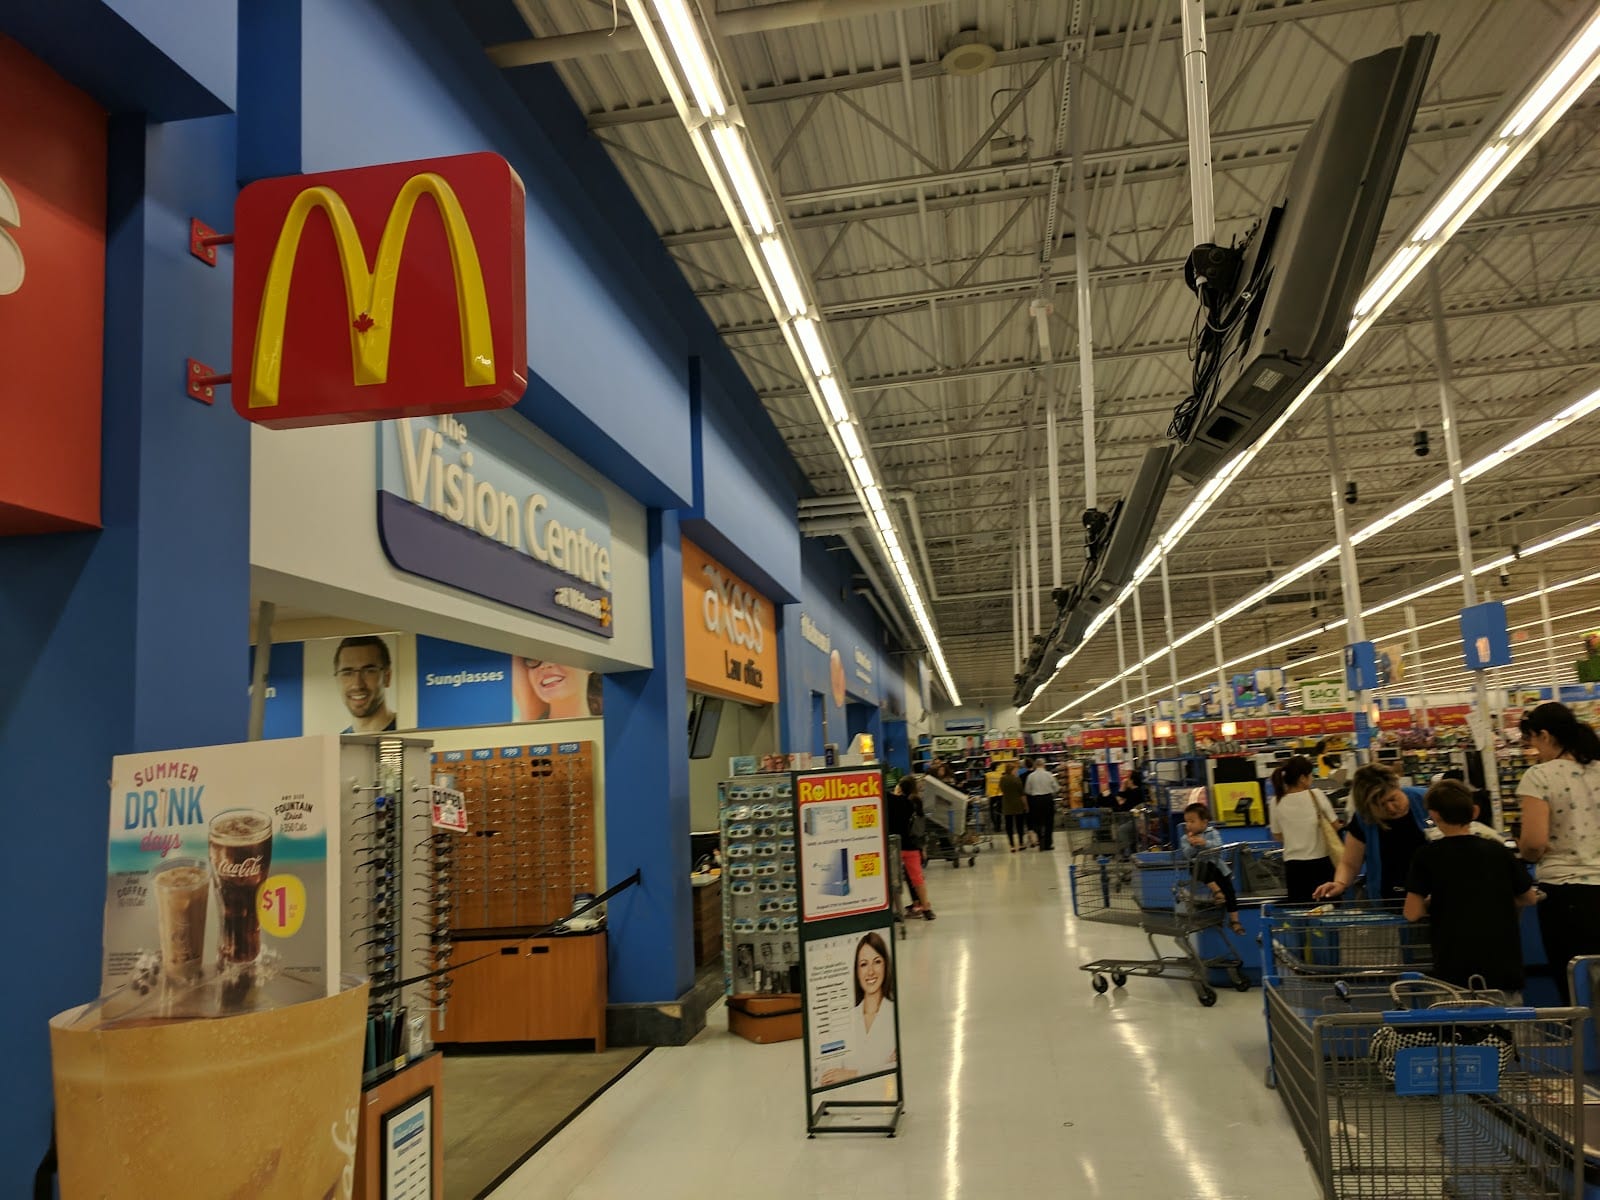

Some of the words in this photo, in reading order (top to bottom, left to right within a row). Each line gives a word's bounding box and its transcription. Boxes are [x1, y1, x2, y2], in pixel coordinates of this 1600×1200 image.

[396, 418, 521, 551] Vision
[525, 493, 611, 590] Centre
[426, 670, 504, 687] Sunglasses
[1310, 687, 1340, 698] BACK
[134, 762, 199, 787] SUMMER
[800, 776, 880, 801] Rollback
[124, 785, 205, 830] DRINK
[274, 801, 313, 816] FOUNTAIN
[140, 830, 183, 858] days
[262, 887, 286, 928] $1
